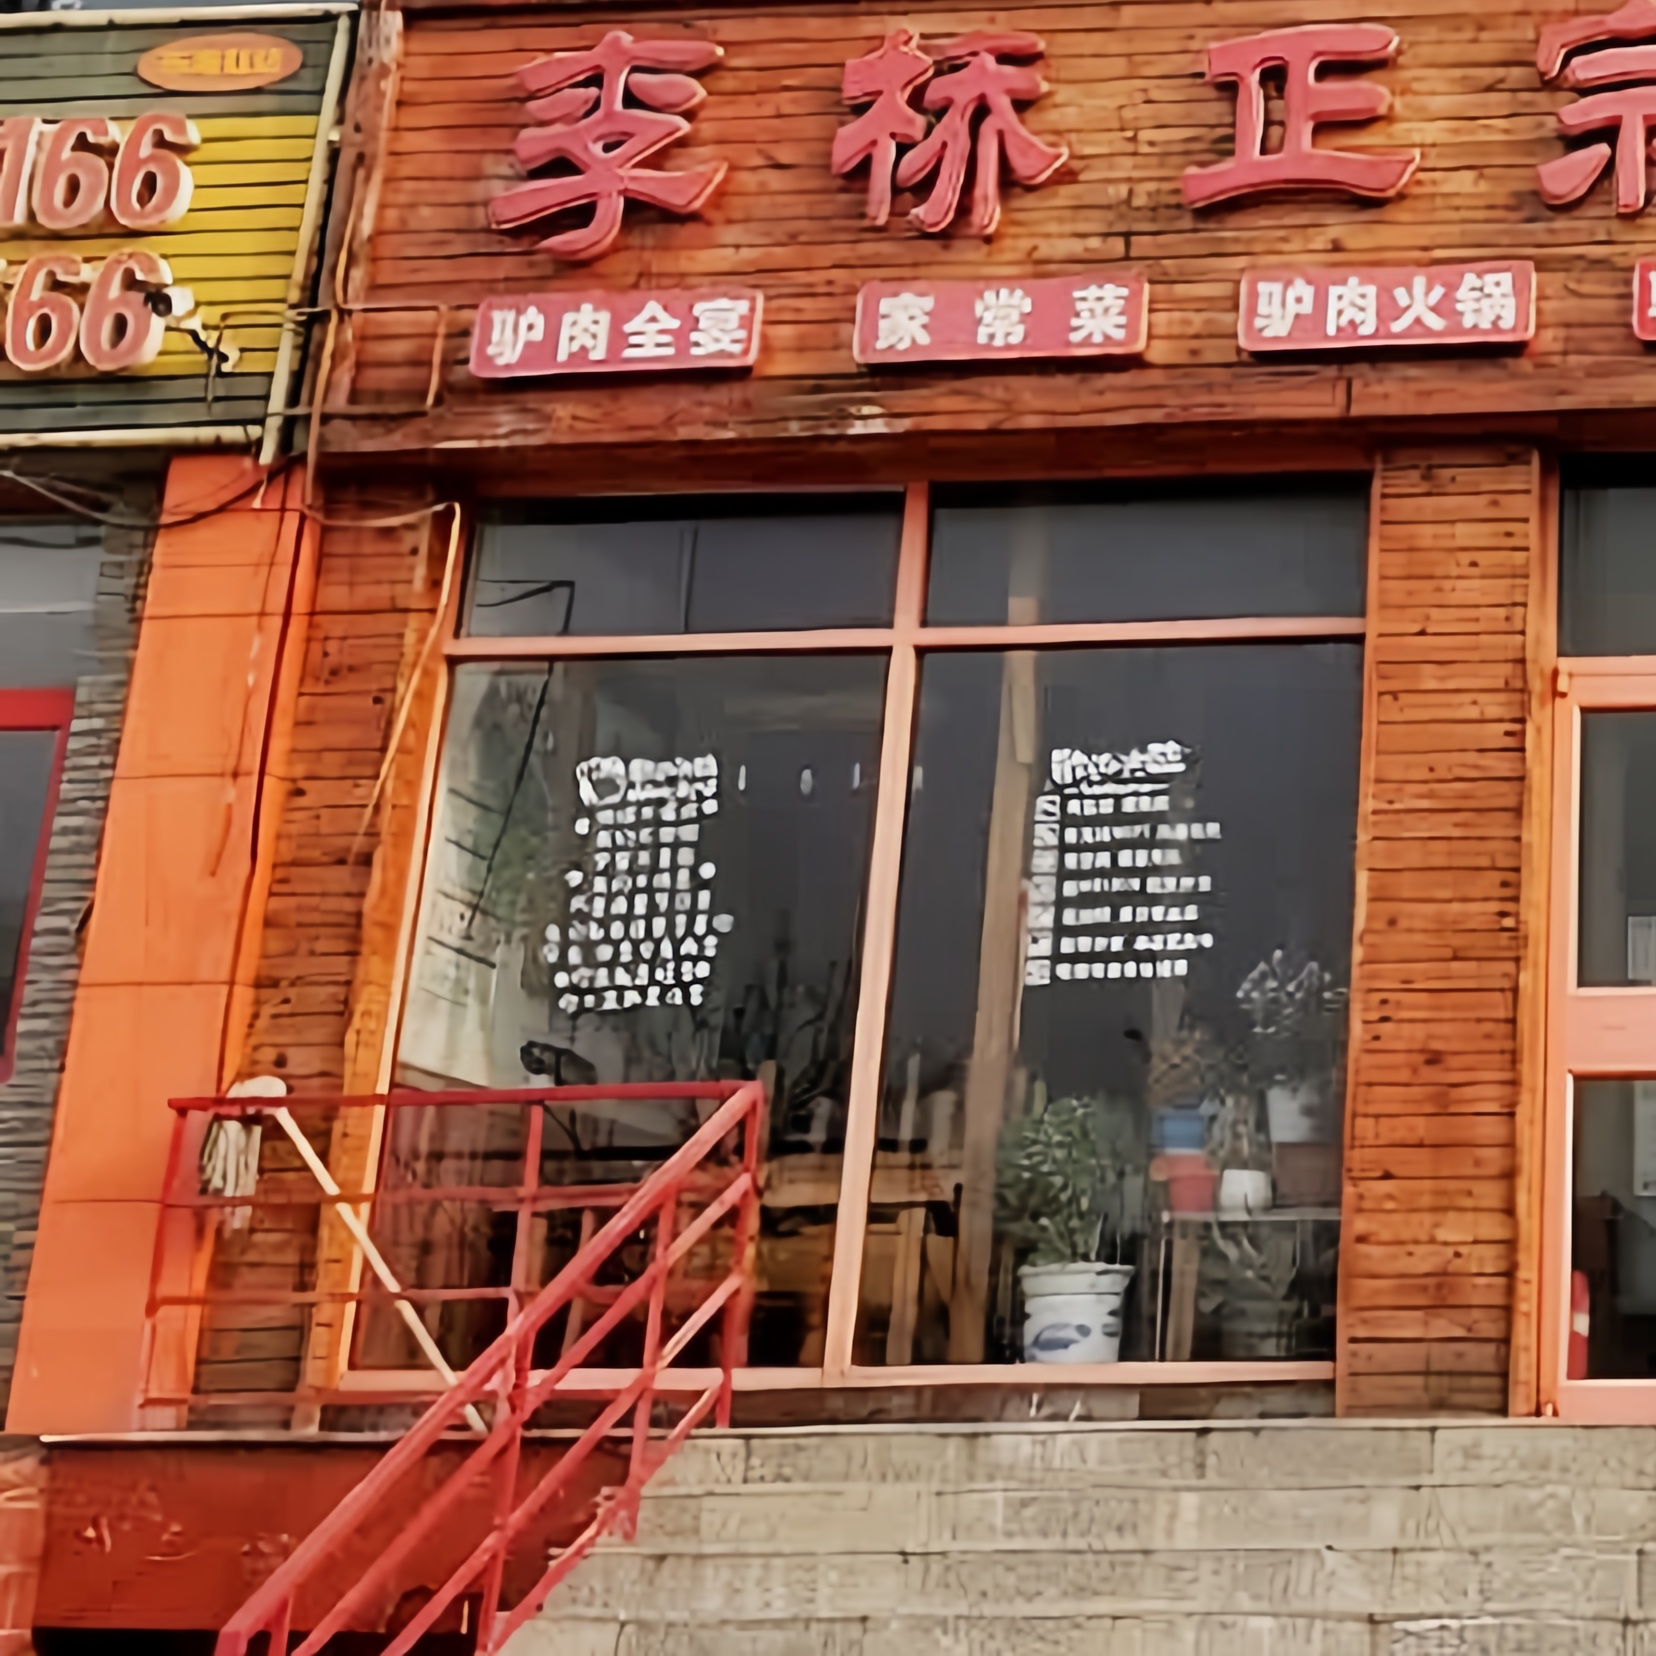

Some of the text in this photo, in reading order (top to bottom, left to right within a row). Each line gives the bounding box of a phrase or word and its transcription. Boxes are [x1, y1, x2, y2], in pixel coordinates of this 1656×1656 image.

[487, 298, 750, 365] 驴肉全宴
[874, 283, 1128, 351] 家常菜
[1254, 272, 1516, 337] 驴肉火锅
